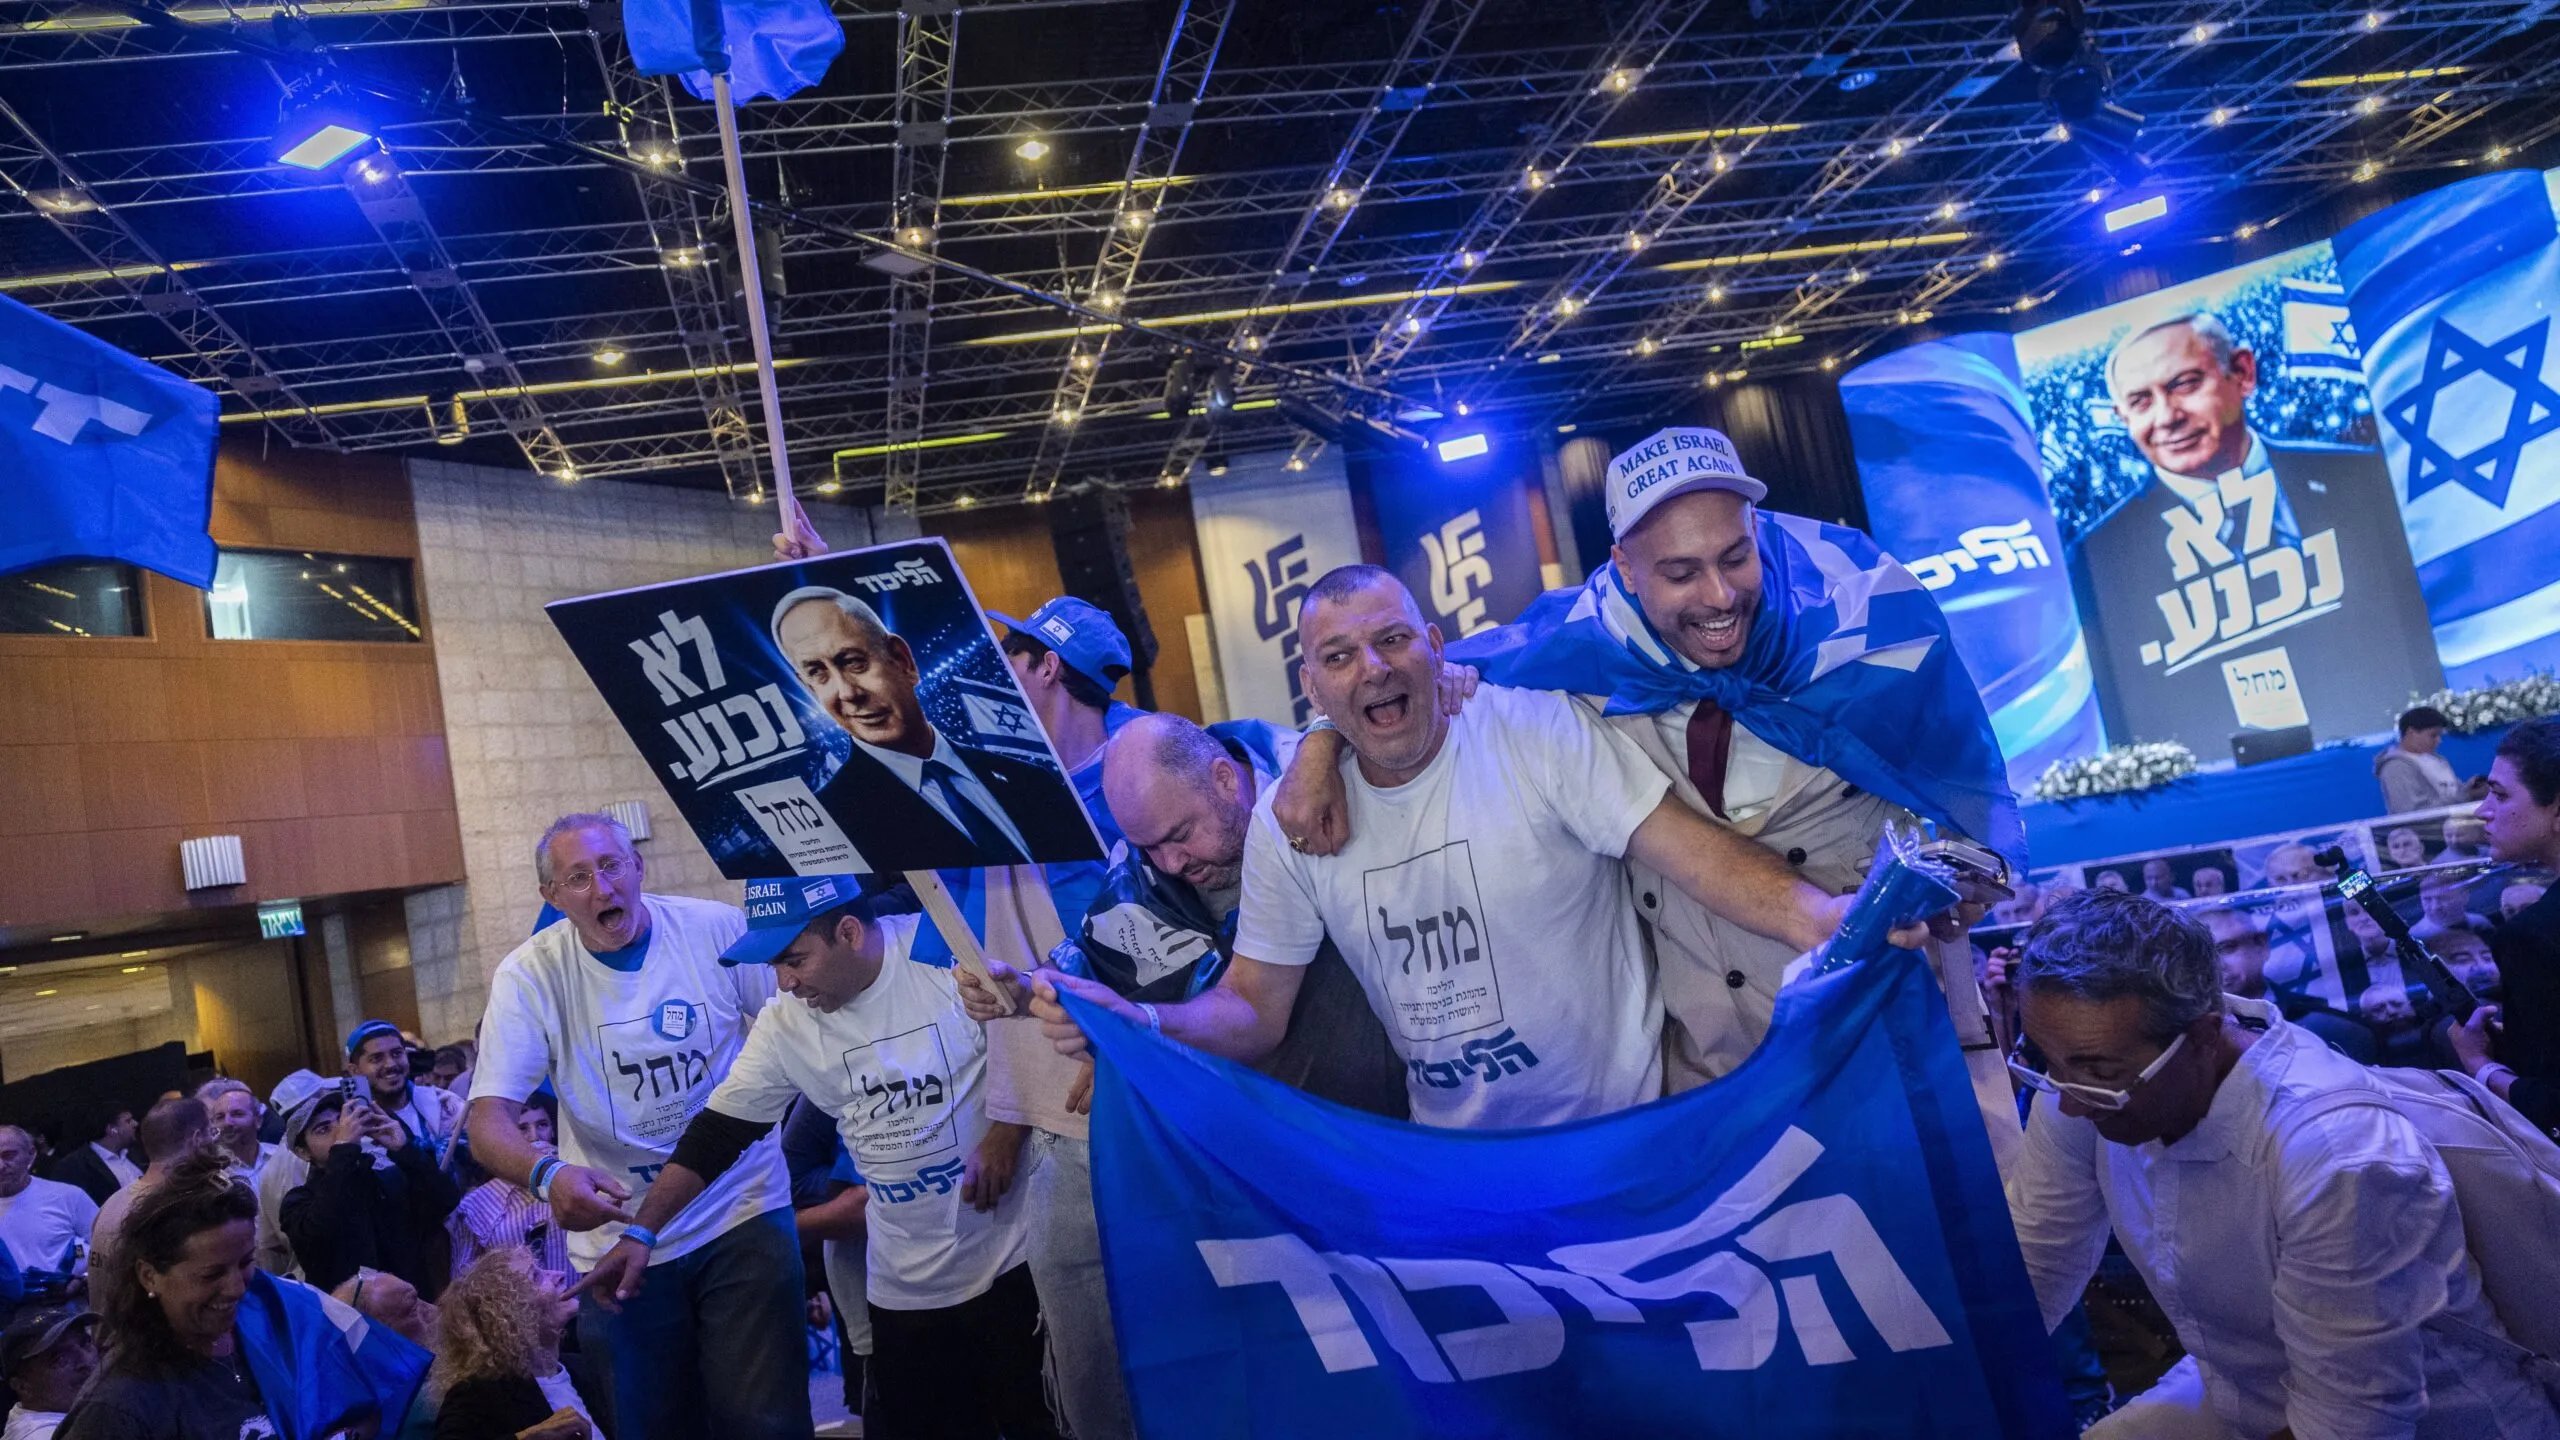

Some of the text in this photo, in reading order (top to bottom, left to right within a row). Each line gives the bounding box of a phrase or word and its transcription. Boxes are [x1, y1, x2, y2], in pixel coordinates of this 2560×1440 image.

[1620, 434, 1729, 478] MAKE ISRAEL
[1627, 455, 1735, 499] GREAT AGAIN
[2161, 467, 2277, 581] לא
[854, 556, 943, 593] הליכוד
[1903, 518, 2050, 592] הליכ
[2140, 528, 2345, 666] נכנע.
[628, 609, 727, 706] לא
[2233, 667, 2286, 696] מחל
[661, 683, 806, 782] נכנע.
[744, 793, 824, 836] מחל
[748, 883, 785, 899] ISRAEL
[751, 902, 787, 918] AGAIN
[1378, 905, 1480, 975] מחל
[666, 1005, 683, 1020] מחל
[612, 1050, 706, 1102] מחל
[861, 1074, 943, 1119] מחל
[1196, 1124, 1953, 1383] הליכוד
